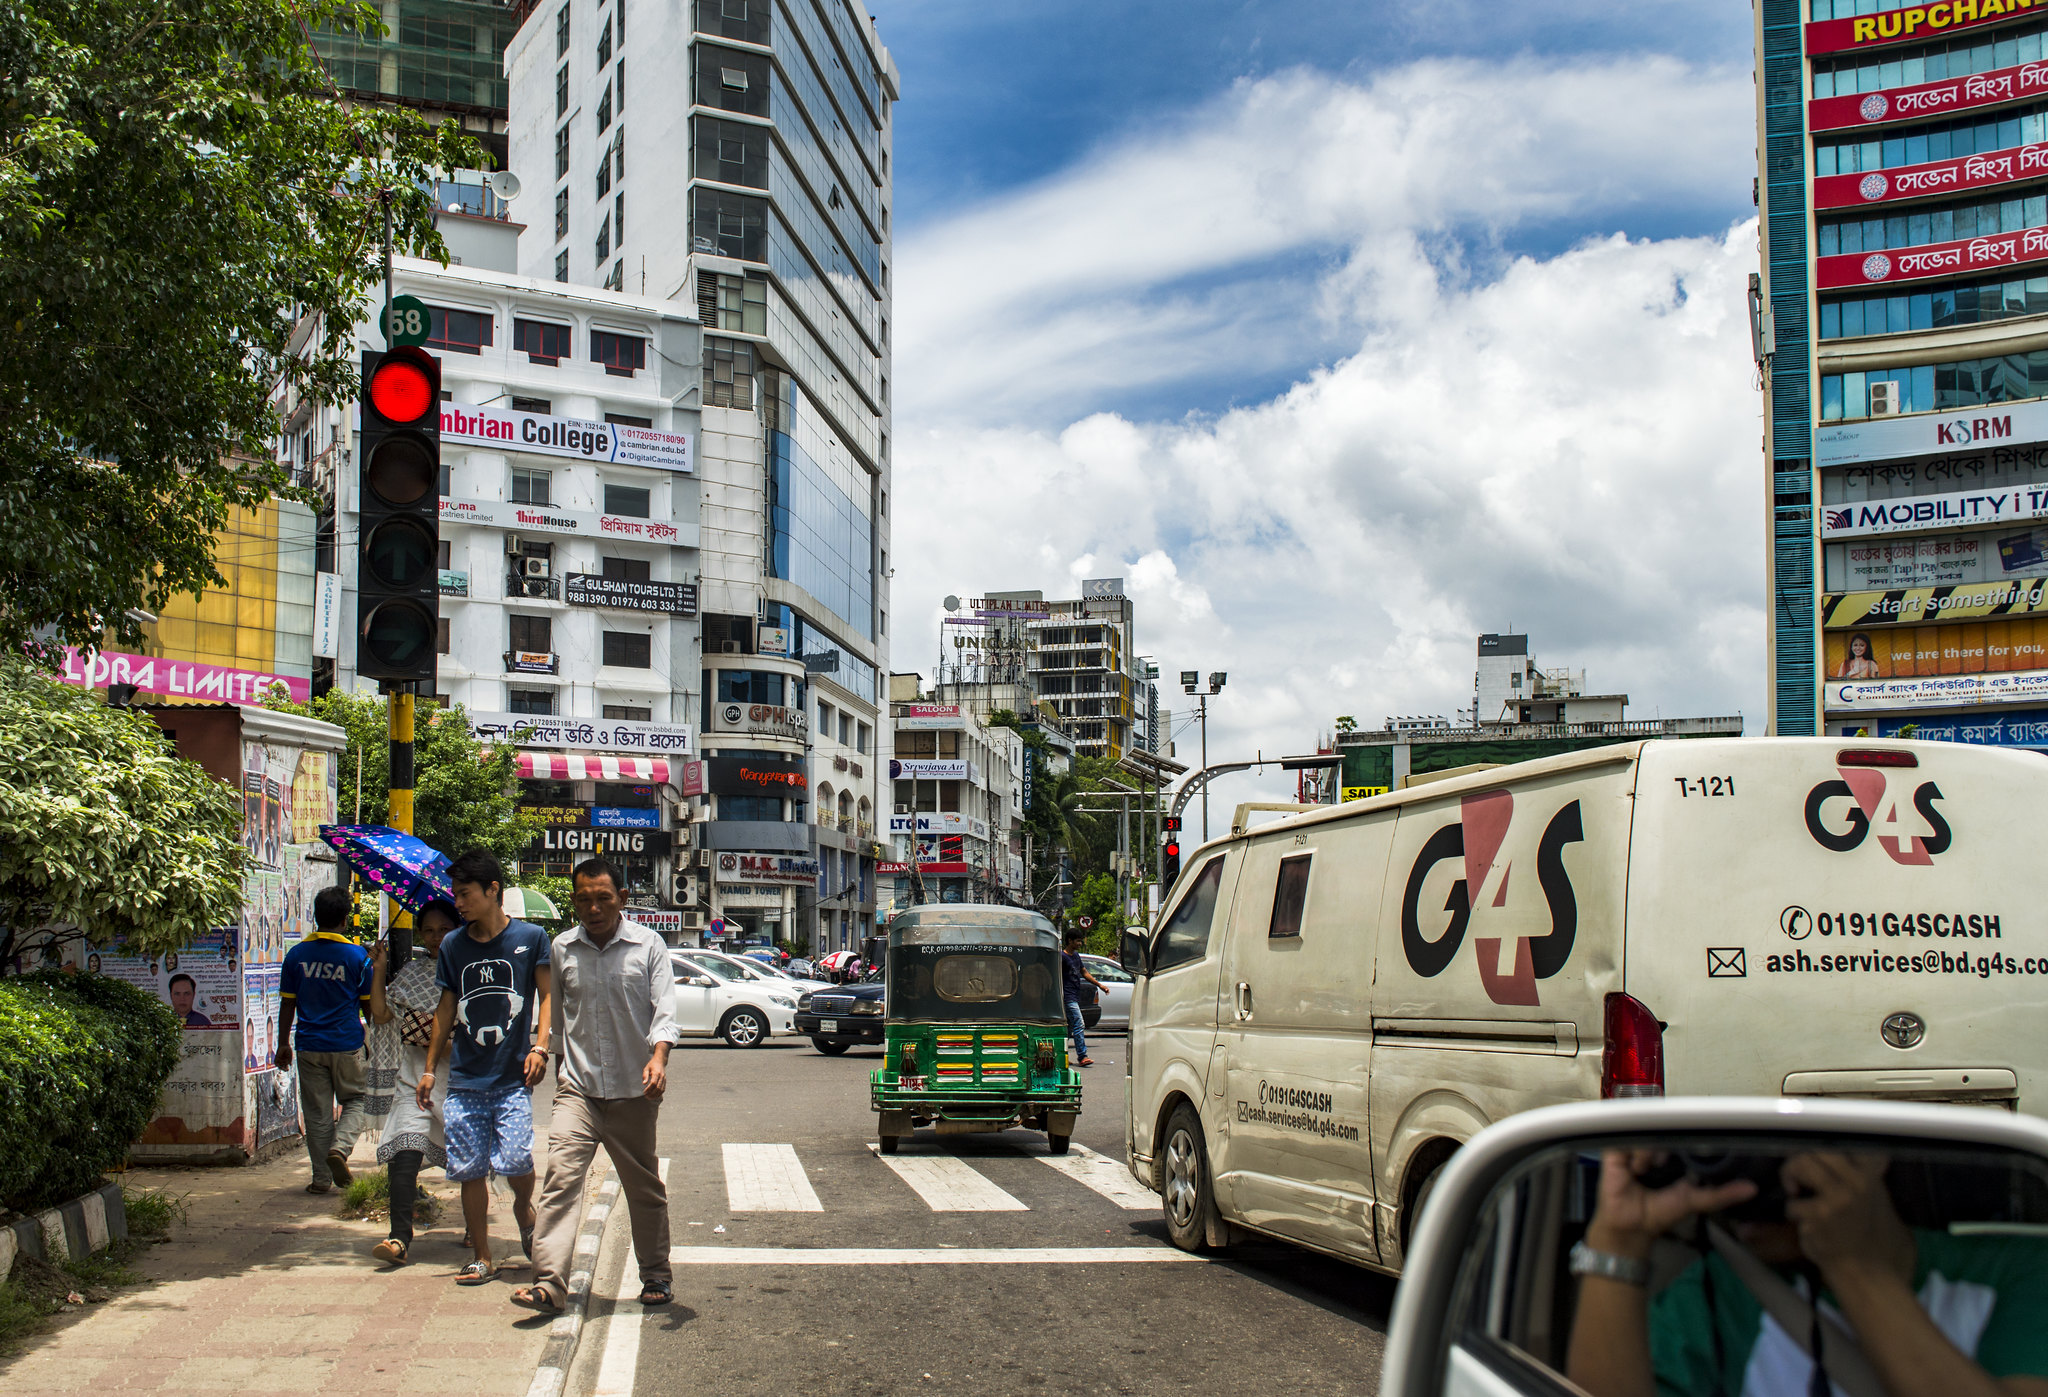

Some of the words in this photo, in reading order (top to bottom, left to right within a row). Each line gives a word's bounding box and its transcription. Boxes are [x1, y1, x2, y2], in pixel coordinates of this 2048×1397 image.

[1895, 86, 1958, 112] সেভেন
[1895, 166, 1958, 191] সেভেন
[1898, 248, 1961, 272] সেভেন
[392, 309, 422, 336] 58
[585, 422, 607, 431] 132140
[1937, 415, 2012, 445] KSRM
[522, 418, 609, 455] College
[626, 429, 686, 445] 01720557180/90
[626, 440, 686, 455] cambrian.edu.bd
[626, 452, 686, 466] /DigitalCambrian
[1845, 463, 1916, 487] শেকড়
[1925, 455, 1986, 481] থেকে
[466, 512, 494, 522] Limited
[1859, 493, 2009, 527] MOBILITY
[516, 523, 577, 533] INTERNATIONAL
[600, 516, 643, 535] প্রিমিয়াম
[586, 578, 627, 594] GULSHAN
[629, 584, 659, 597] TOURS
[660, 587, 676, 598] LTD.
[568, 592, 609, 606] 9881390,
[611, 596, 638, 608] 01976
[641, 600, 657, 610] 603
[660, 602, 676, 611] 336
[1869, 597, 1919, 615] start
[1926, 585, 2044, 611] something
[521, 653, 549, 663] BSB
[1890, 651, 1912, 661] we
[1916, 650, 1940, 661] are
[1944, 647, 1984, 658] there
[1988, 645, 2010, 657] for
[2014, 642, 2046, 657] you,
[966, 654, 1027, 669] PLAZA
[1888, 683, 1918, 693] ব্যাংক
[1945, 688, 1996, 696] Securities
[726, 710, 741, 719] GPH
[749, 705, 785, 724] GPH
[564, 724, 594, 743] ভর্তি
[598, 731, 608, 745] ও
[614, 726, 645, 746] ভিসা
[649, 734, 687, 749] প্রসেস
[635, 725, 687, 734] www.bsbbd.com
[1960, 718, 2004, 744] কমার্স
[740, 768, 787, 787] Manyavar
[903, 763, 948, 773] Sriwijaya
[949, 763, 964, 771] Air
[1024, 751, 1032, 806] FERDOUS
[1675, 776, 1736, 798] T-121
[1348, 788, 1382, 799] SALE
[1167, 819, 1178, 830] 37
[1804, 767, 1952, 866] G4S
[544, 829, 644, 852] LIGHTING
[740, 856, 778, 871] M.K.
[720, 886, 752, 895] HAMID
[755, 886, 781, 896] TOWER
[1401, 788, 1585, 1007] G4S
[624, 914, 679, 923] L-MADINA
[1817, 912, 2001, 938] 0191G4SCASH
[300, 961, 347, 982] VISA
[1268, 1084, 1333, 1114] 0191G4SCASH
[1248, 1105, 1359, 1142] cash.services@bd.g4s.com
